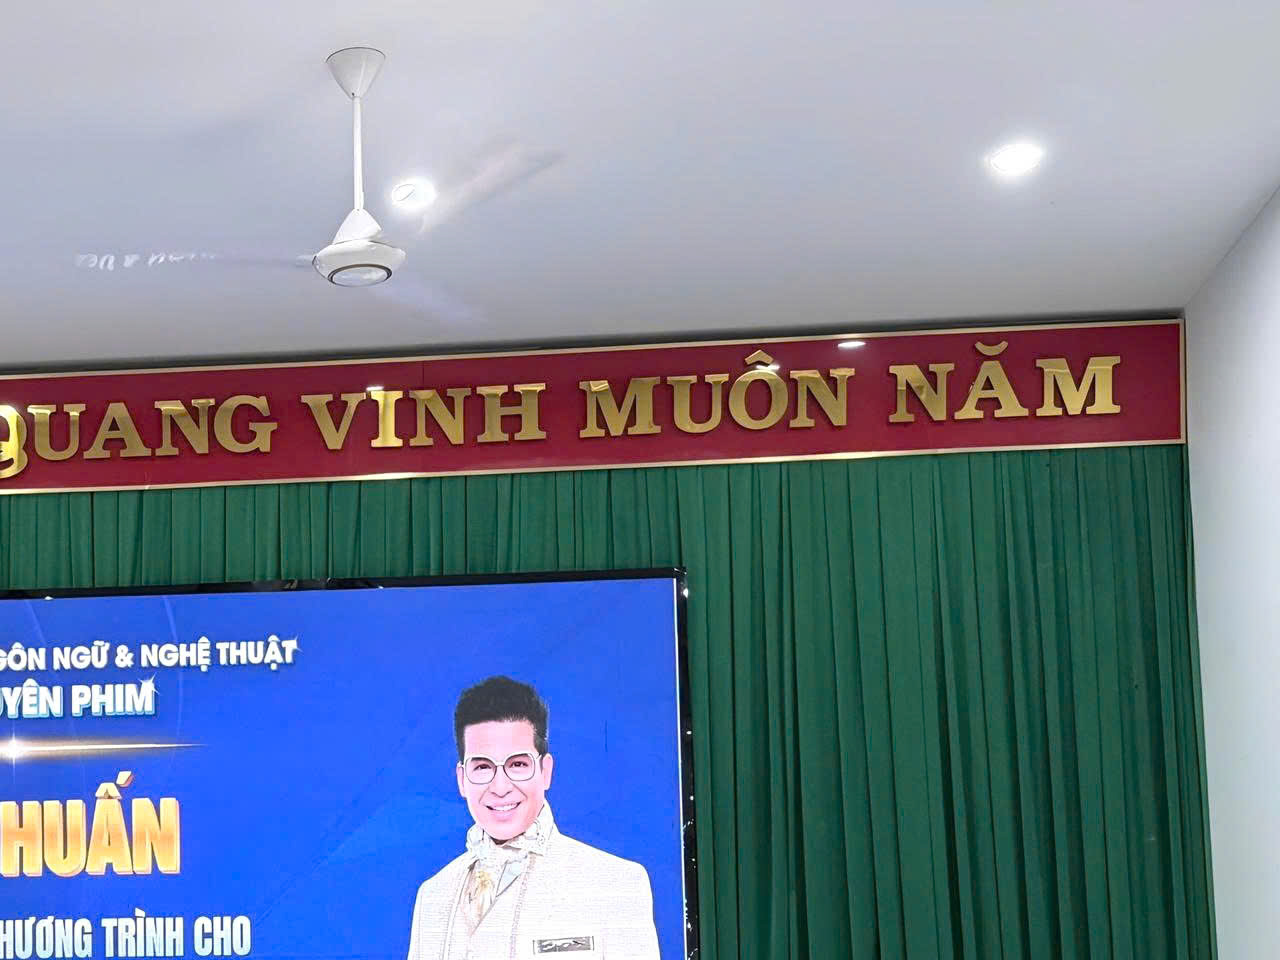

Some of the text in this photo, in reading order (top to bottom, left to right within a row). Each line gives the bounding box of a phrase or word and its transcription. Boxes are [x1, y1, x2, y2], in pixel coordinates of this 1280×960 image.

[301, 382, 547, 450] VINH
[579, 350, 856, 437] MUÔN
[889, 341, 1121, 422] NĂM
[53, 640, 109, 671] NGỮ
[115, 645, 134, 669] &
[140, 636, 211, 672] NGHỆ
[216, 635, 298, 670] THUẬT
[71, 680, 156, 717] PHIM
[0, 771, 180, 877] HUẤN
[101, 908, 185, 958] TRÌNH
[193, 915, 252, 957] CHO
